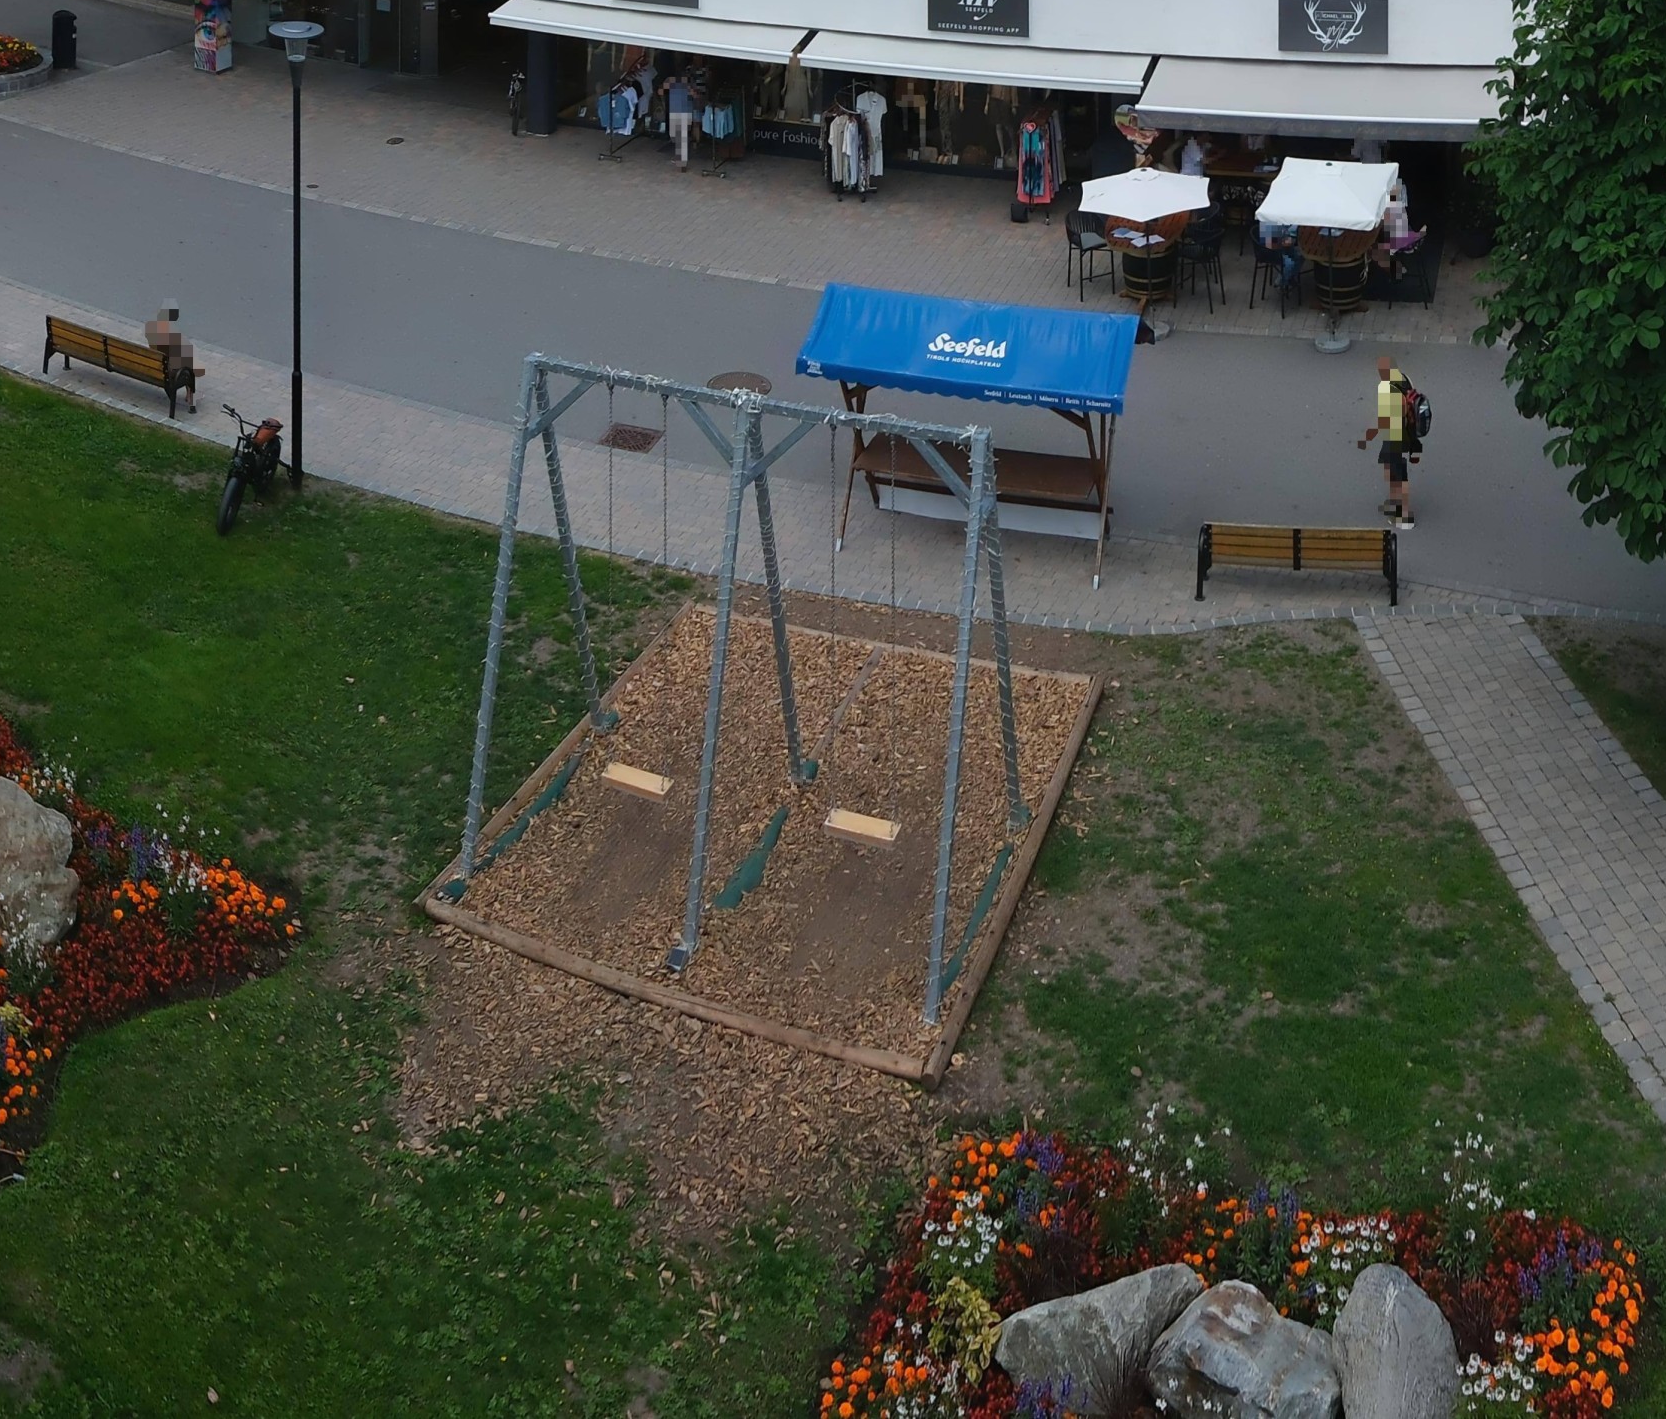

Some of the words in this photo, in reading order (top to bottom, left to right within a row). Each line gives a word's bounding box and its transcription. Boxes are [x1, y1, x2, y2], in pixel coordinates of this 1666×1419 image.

[965, 6, 994, 14] SEEFELD
[937, 22, 967, 30] SEEFELD
[969, 25, 1004, 33] SHOPPING
[754, 129, 779, 141] pure
[783, 129, 821, 146] fashio
[928, 332, 1007, 360] Seefeld
